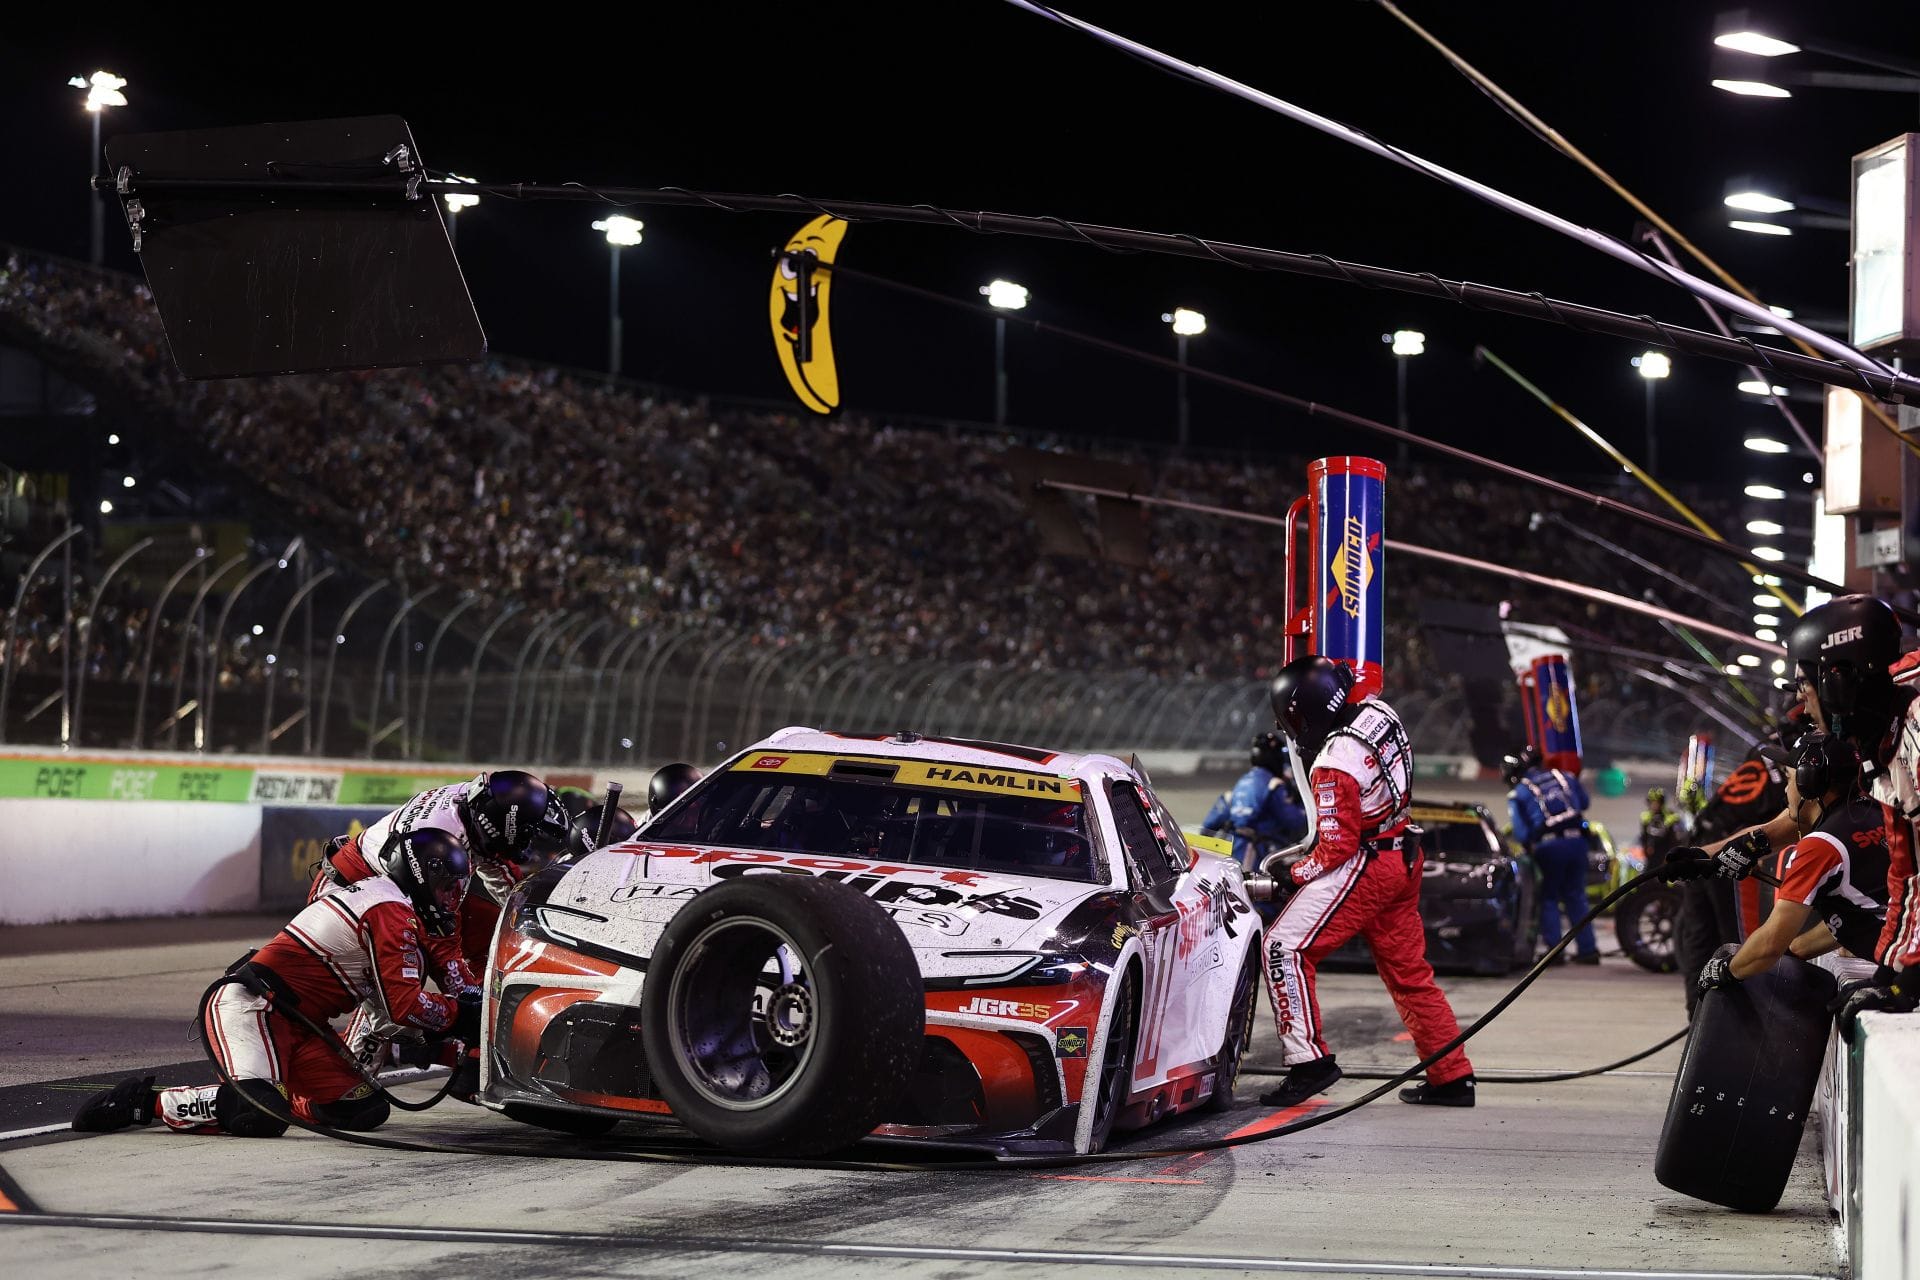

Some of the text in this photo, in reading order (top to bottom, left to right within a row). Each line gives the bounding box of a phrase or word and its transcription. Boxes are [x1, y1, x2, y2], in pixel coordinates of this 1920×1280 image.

[1343, 516, 1366, 618] SUNOCO
[1821, 626, 1863, 650] JGR
[926, 767, 1062, 794] HAMLIN
[404, 839, 425, 884] SportClips
[608, 844, 989, 888] Sport
[1058, 1038, 1086, 1049] SUNOCO
